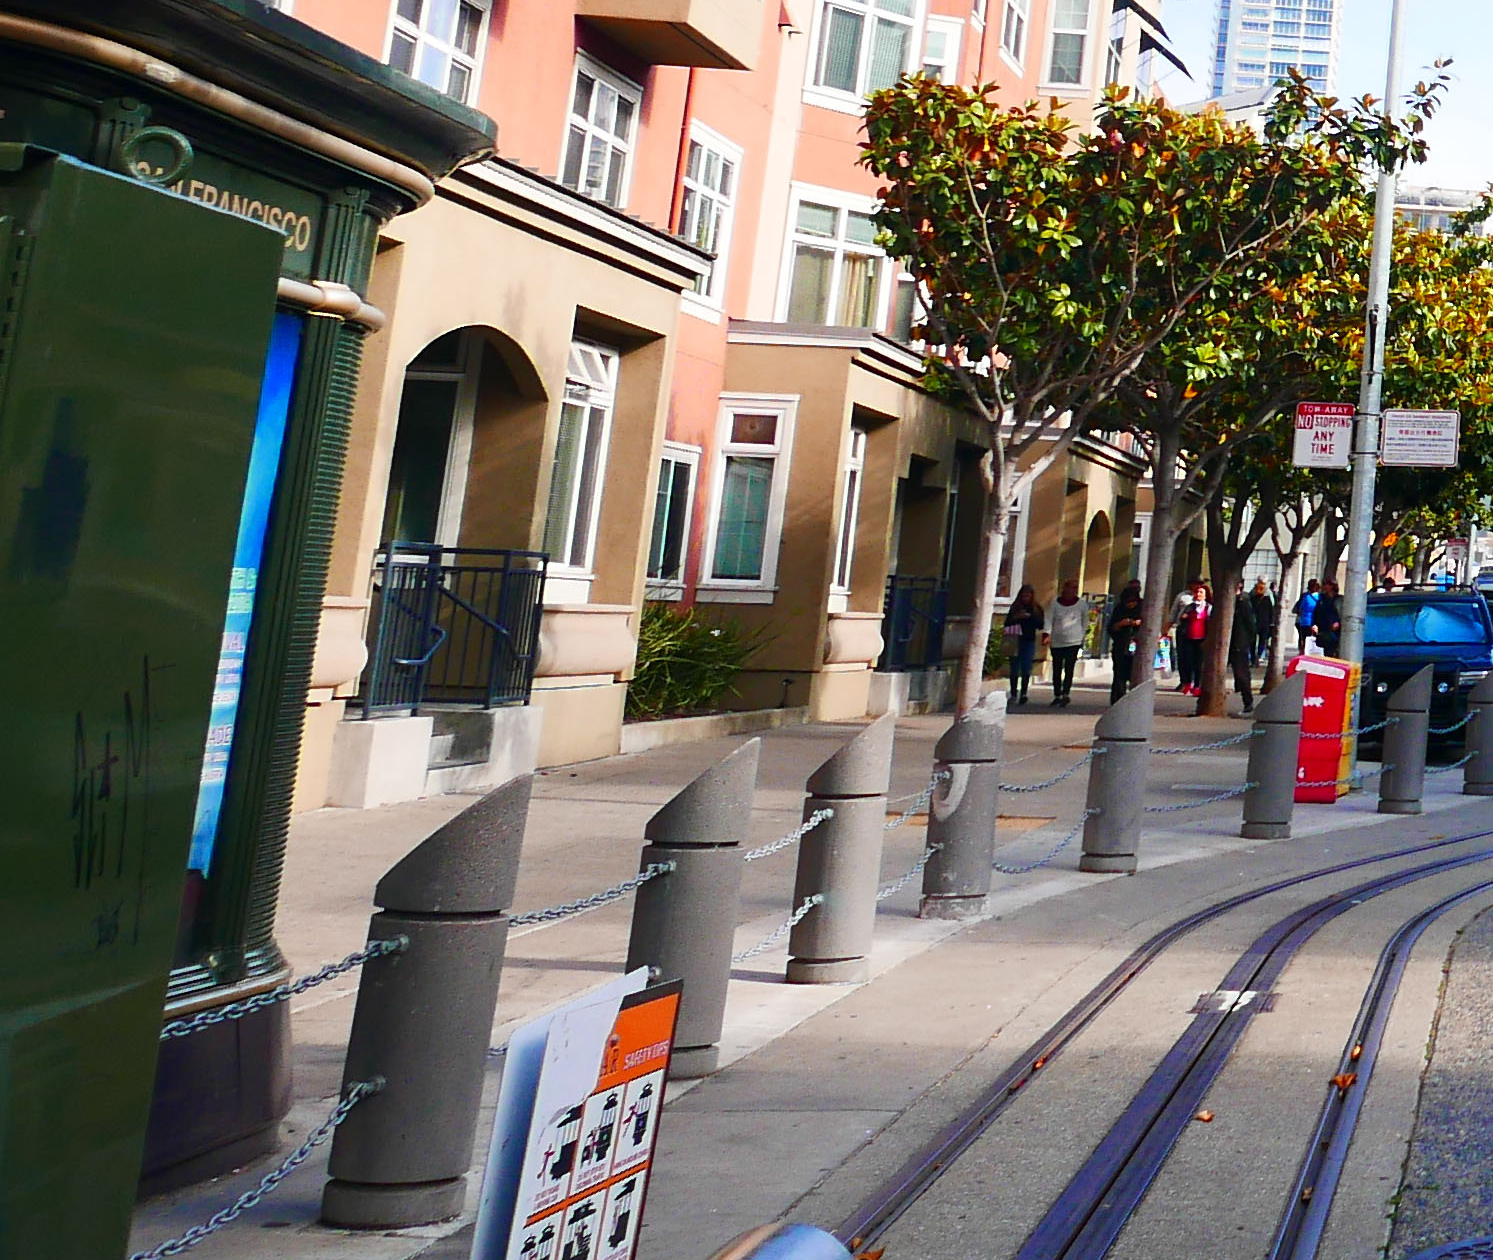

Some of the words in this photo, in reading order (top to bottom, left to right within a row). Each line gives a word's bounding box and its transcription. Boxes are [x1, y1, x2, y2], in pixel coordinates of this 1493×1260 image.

[1297, 415, 1313, 429] NO
[1315, 416, 1350, 428] STOPPING
[1313, 430, 1335, 441] ANY
[1311, 443, 1334, 455] TIME
